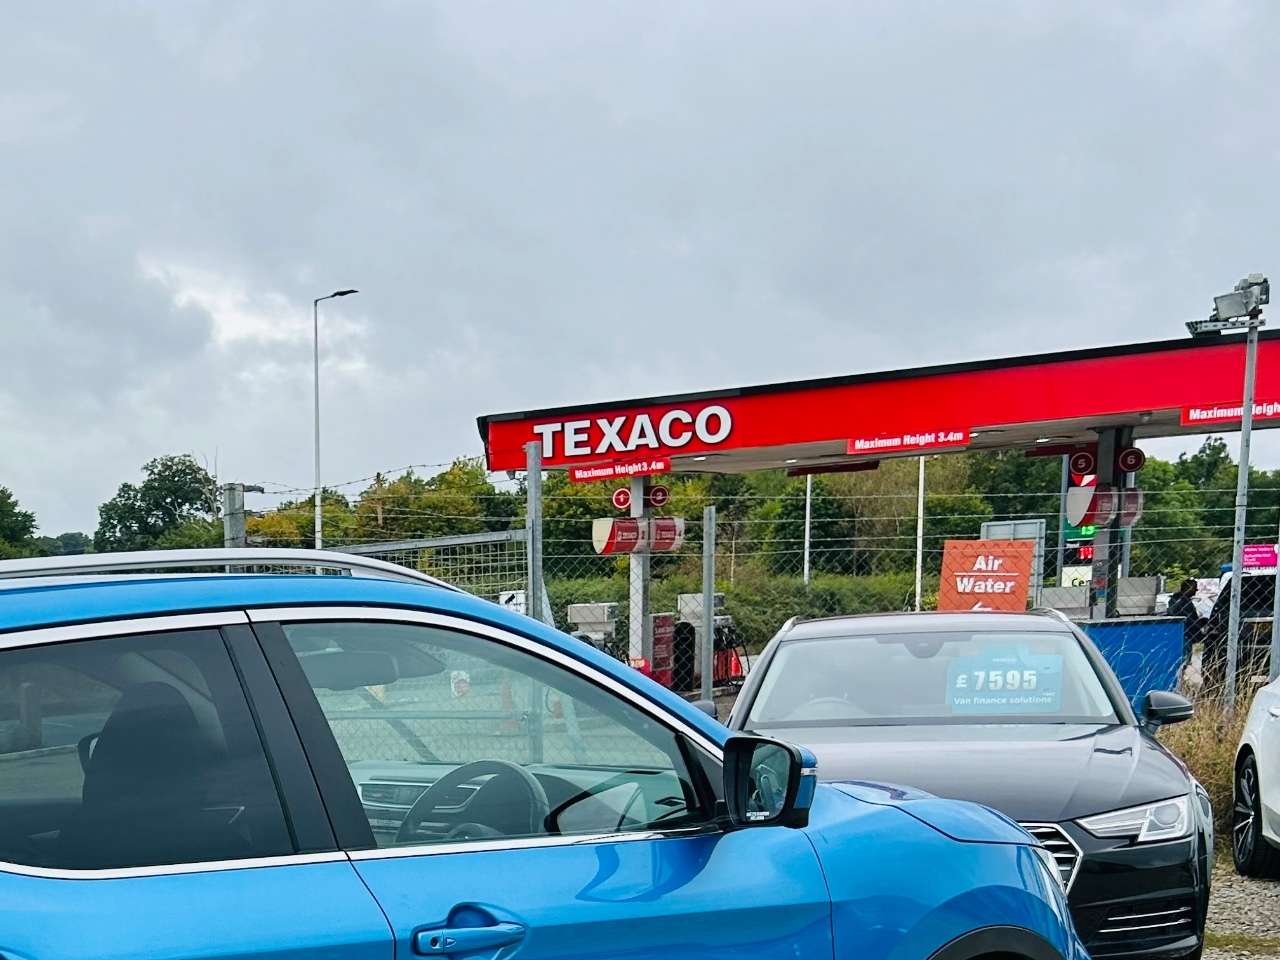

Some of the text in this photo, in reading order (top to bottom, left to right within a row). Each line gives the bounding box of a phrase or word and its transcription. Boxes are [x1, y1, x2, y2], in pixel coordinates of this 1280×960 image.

[1188, 407, 1244, 420] Maximum
[533, 405, 732, 458] TEXACO
[854, 431, 964, 449] Maximum Height 3.4m
[574, 468, 614, 480] Maximum
[614, 464, 643, 475] Height
[972, 555, 1003, 571] Air
[956, 577, 1016, 593] Water
[956, 670, 1038, 690] £ 7595
[953, 696, 1053, 705] Van finance solutions
